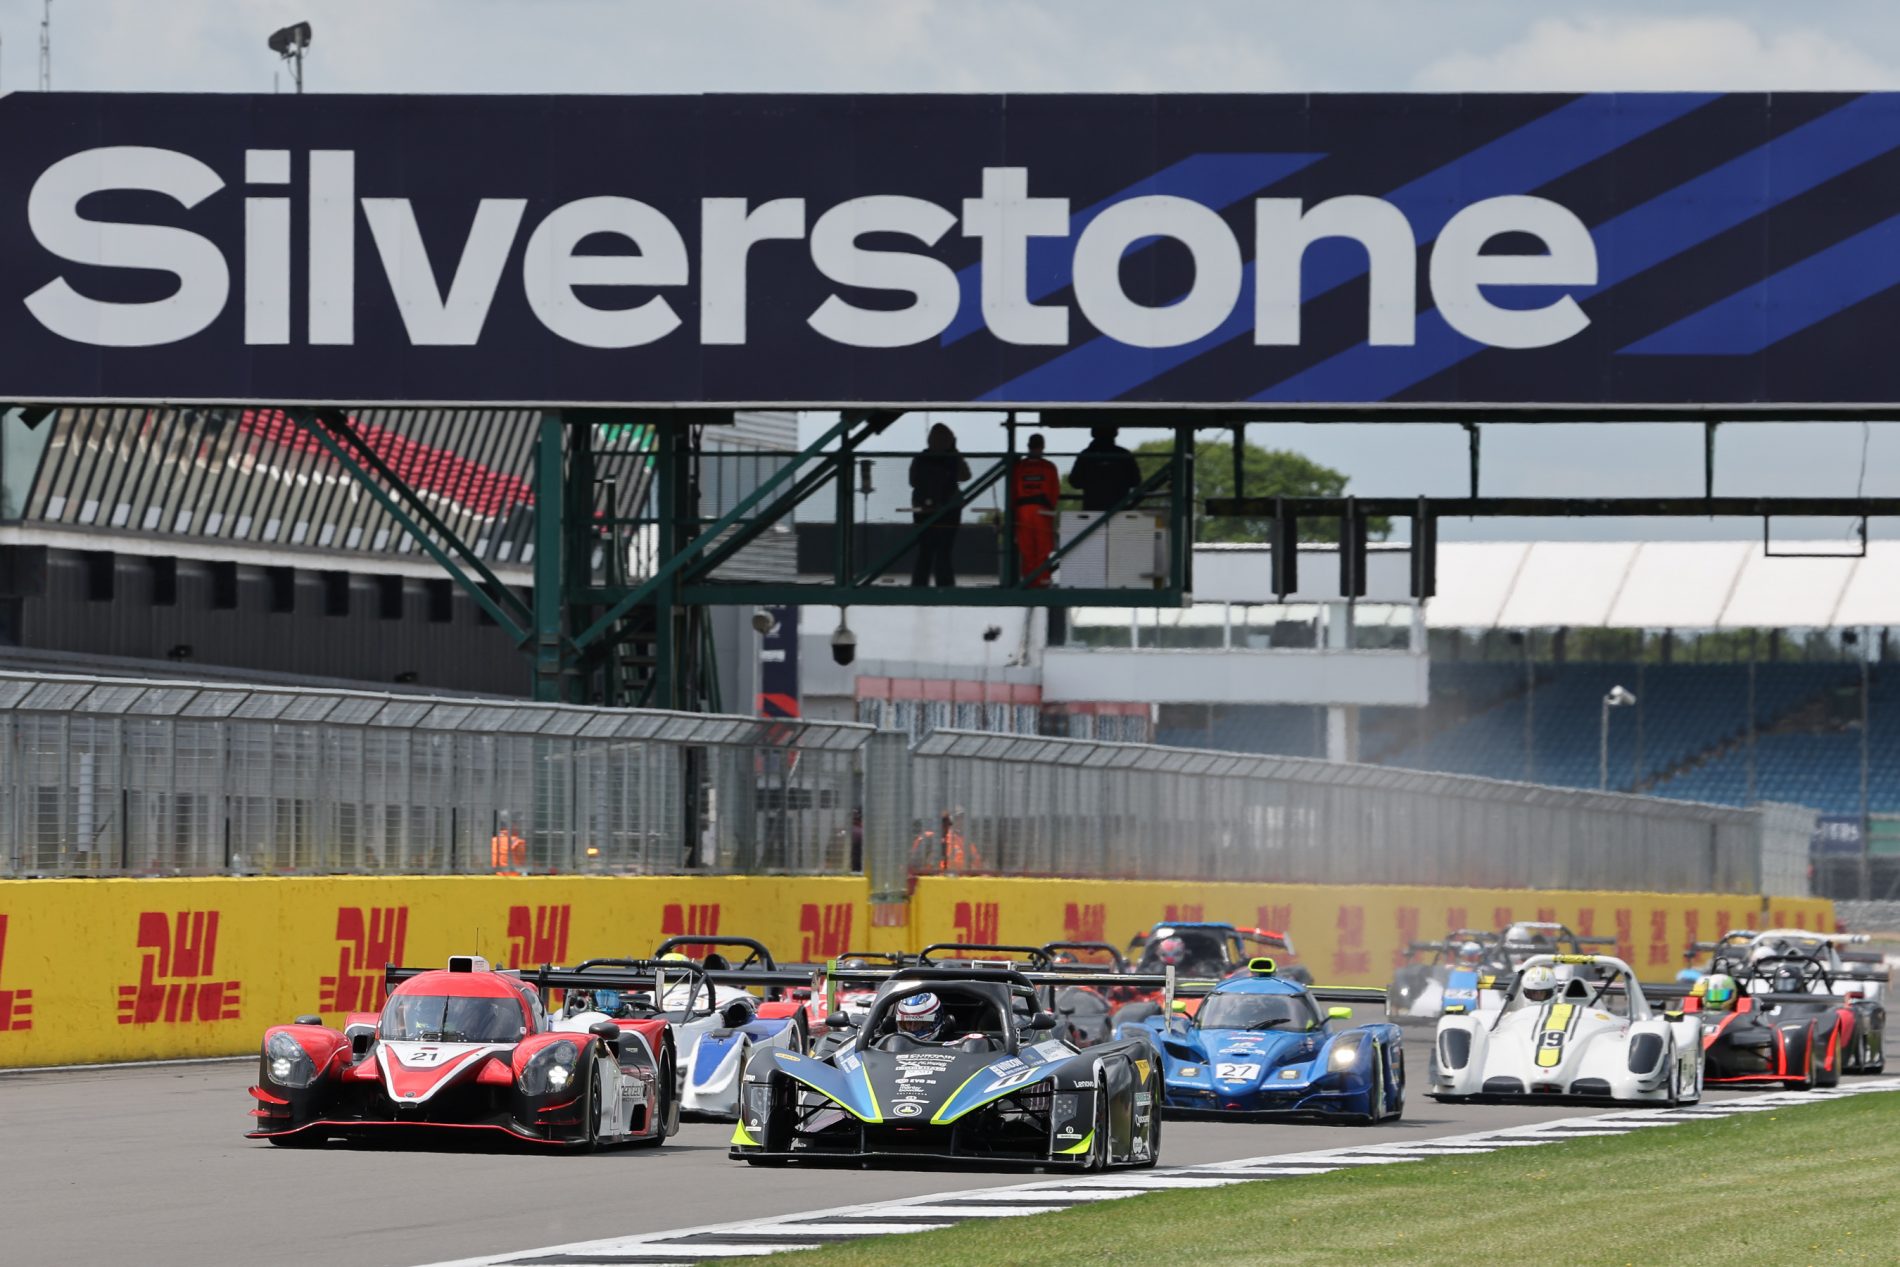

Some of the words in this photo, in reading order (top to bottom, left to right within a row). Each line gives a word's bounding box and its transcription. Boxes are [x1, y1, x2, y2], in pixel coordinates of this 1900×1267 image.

[23, 146, 1598, 349] Silverstone
[132, 911, 224, 1024] DHL
[1538, 1032, 1564, 1047] 19
[411, 1053, 438, 1061] 21
[1222, 1065, 1252, 1077] 27
[1073, 1080, 1096, 1088] Lenov
